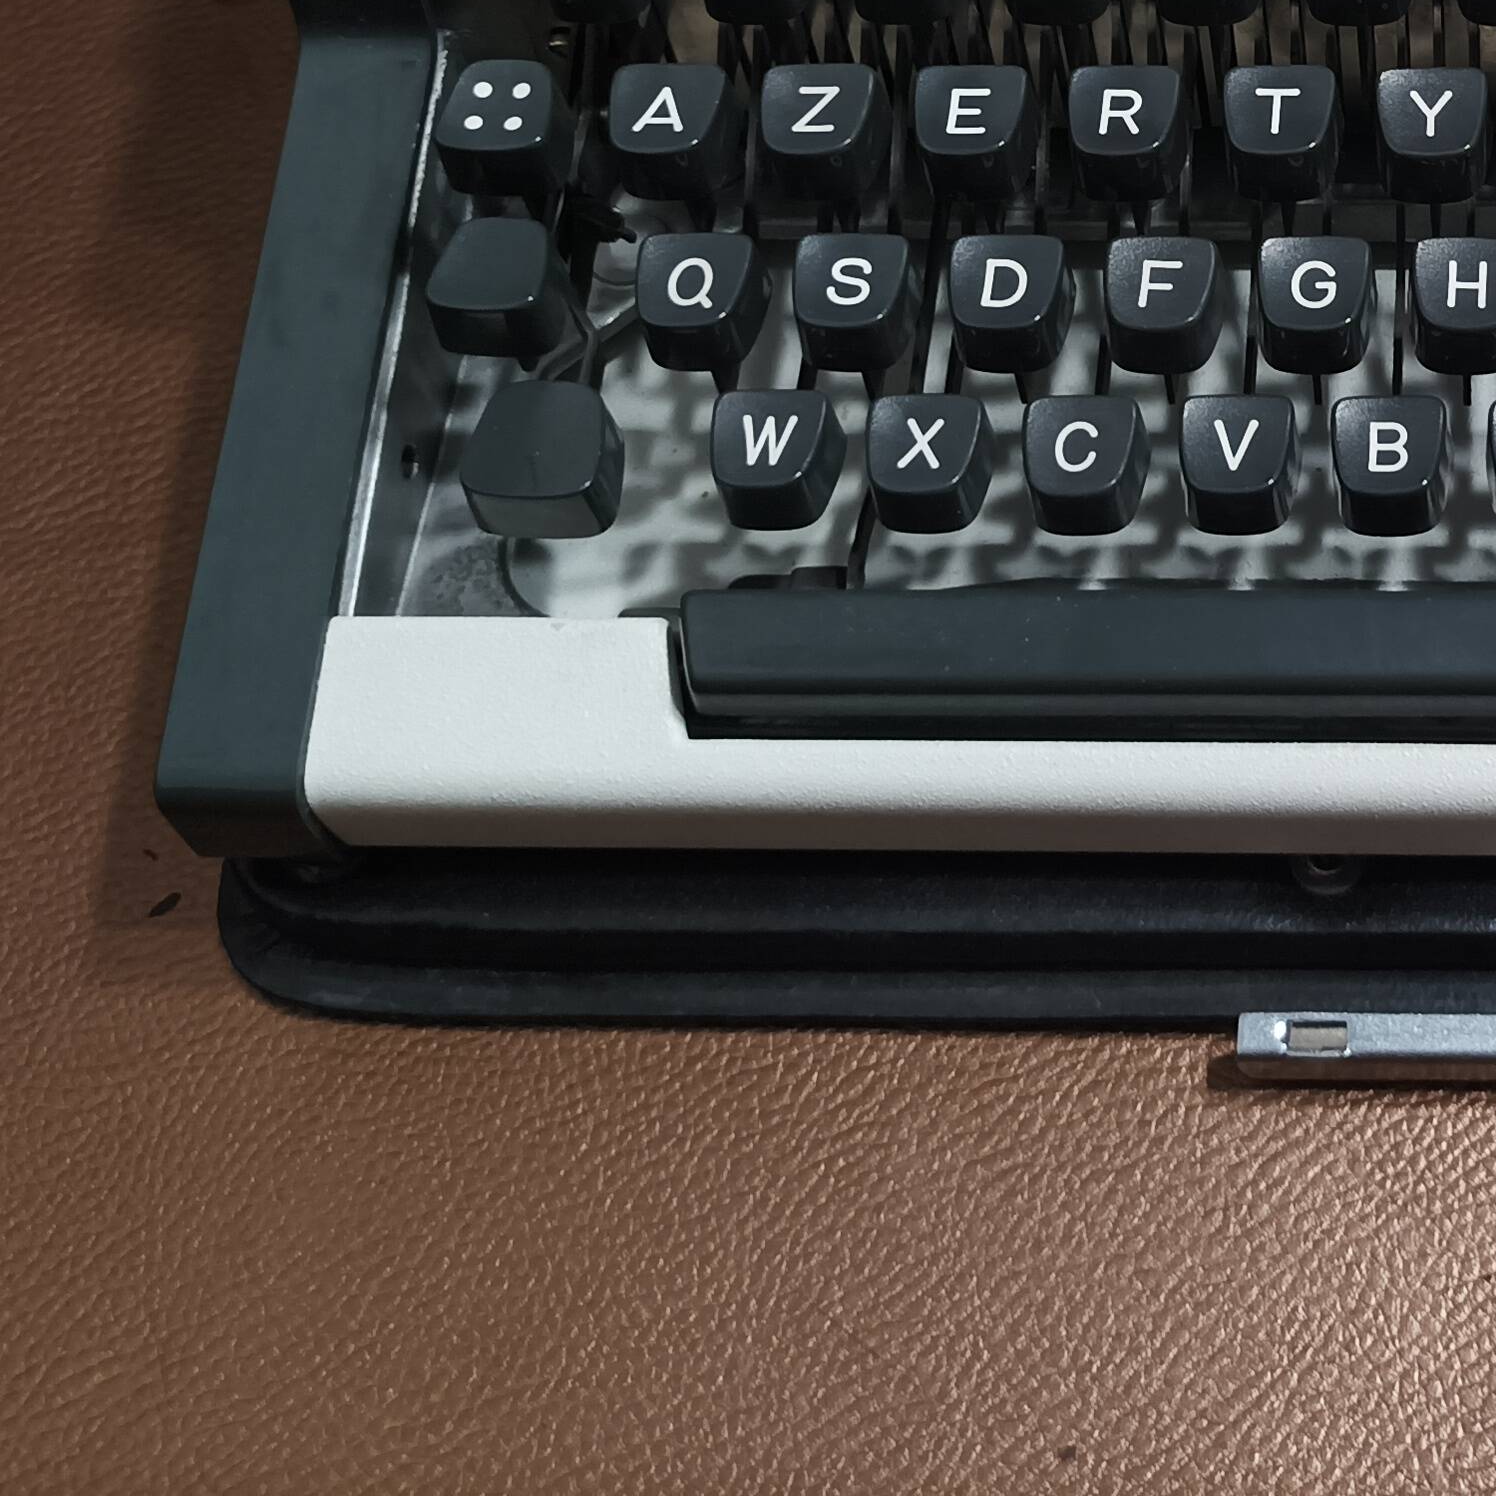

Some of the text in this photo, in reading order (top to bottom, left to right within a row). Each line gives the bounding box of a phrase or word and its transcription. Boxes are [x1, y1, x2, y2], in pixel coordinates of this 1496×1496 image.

[631, 86, 684, 132] A
[791, 86, 840, 133] Z
[945, 88, 991, 135] E
[1098, 88, 1143, 135] R
[1255, 87, 1301, 135] T
[1409, 90, 1453, 137] Y
[667, 257, 714, 309] Q
[826, 257, 873, 306] S
[980, 258, 1028, 308] D
[1137, 259, 1184, 308] F
[1291, 260, 1337, 309] G
[1446, 259, 1488, 309] H
[742, 414, 799, 466] W
[897, 417, 945, 469] X
[1054, 421, 1099, 473] C
[1213, 419, 1260, 471] V
[1367, 421, 1409, 473] B
